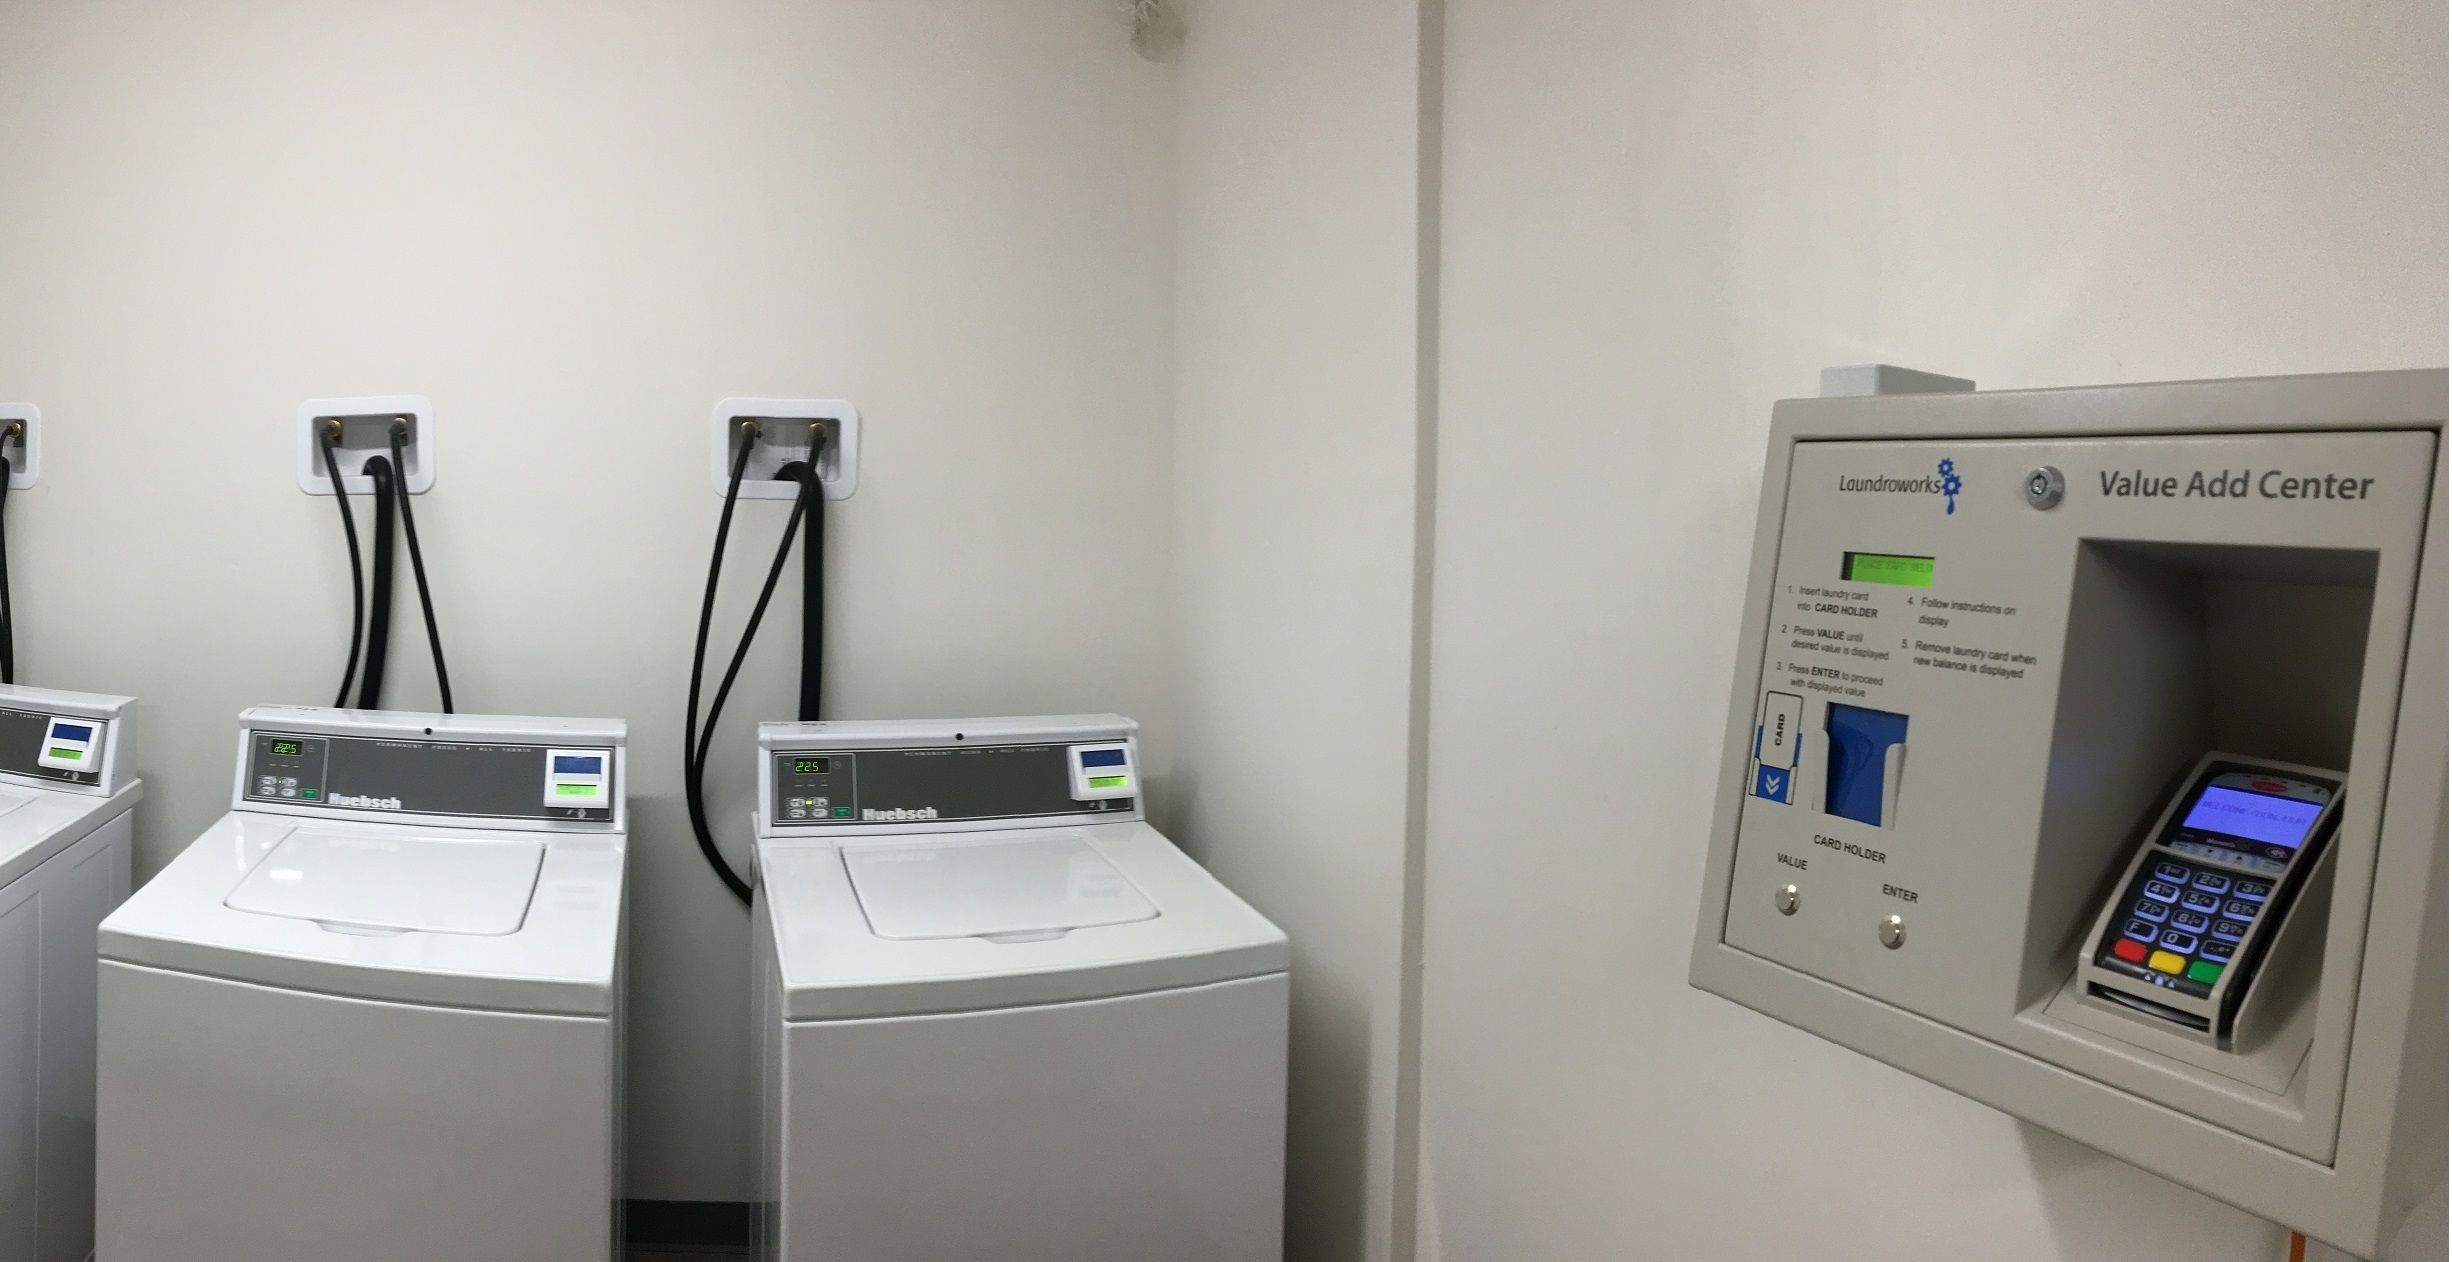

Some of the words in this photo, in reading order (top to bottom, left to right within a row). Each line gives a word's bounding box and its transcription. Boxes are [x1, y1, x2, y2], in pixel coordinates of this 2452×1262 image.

[1839, 475, 1941, 495] Laundroworks
[2100, 469, 2178, 497] Value
[2185, 469, 2251, 498] Add
[2258, 470, 2375, 499] Center
[1800, 586, 1821, 596] Insert
[1822, 588, 1849, 600] laundry
[1851, 592, 1869, 601] card
[1797, 602, 1811, 611] into
[1814, 603, 1839, 614] CARD
[1841, 606, 1878, 618] HOLDER
[1921, 597, 1949, 609] Follow
[1950, 600, 2002, 615] instructions
[2004, 607, 2016, 615] on
[1918, 614, 1950, 628] display
[1793, 625, 1815, 636] Press
[1817, 629, 1845, 640] VALUE
[1846, 633, 1863, 642] until
[1791, 640, 1819, 650] desired
[1821, 644, 1841, 653] value
[1843, 647, 1849, 655] is
[1851, 647, 1889, 661] displayed
[1915, 640, 1951, 654] Remove
[1953, 645, 1987, 660] laundry
[1988, 651, 2009, 661] card
[2011, 654, 2037, 665] when
[1788, 663, 1809, 674] Press
[1811, 666, 1840, 679] ENTER
[1842, 672, 1849, 680] to
[1851, 674, 1884, 686] proceed
[1913, 657, 1931, 666] new
[1933, 658, 1967, 671] balance
[1969, 664, 1977, 673] is
[1979, 664, 2025, 679] displayed
[1790, 679, 1805, 687] with
[1807, 680, 1843, 694] displayed
[1844, 687, 1866, 697] value
[1774, 713, 1786, 746] CARD
[795, 761, 819, 772] 225
[328, 792, 402, 809] Huebsch
[862, 806, 938, 821] Huebsch
[1813, 834, 1842, 851] CARD
[1843, 843, 1887, 864] HOLDER
[1777, 852, 1808, 871] VALUE
[1882, 884, 1919, 903] ENTER
